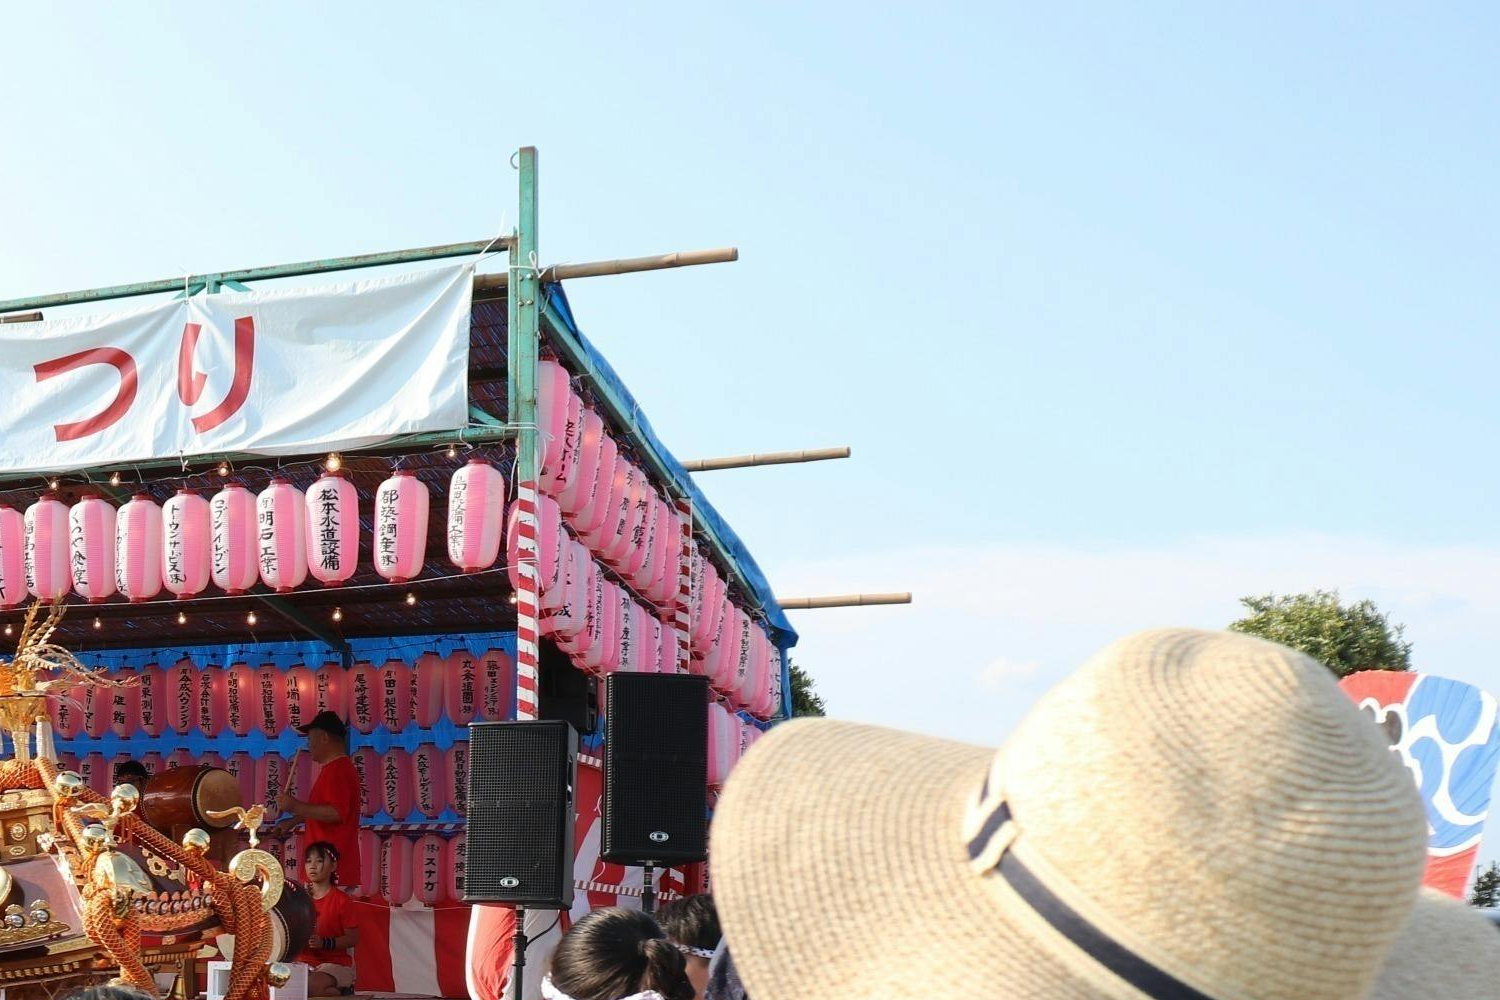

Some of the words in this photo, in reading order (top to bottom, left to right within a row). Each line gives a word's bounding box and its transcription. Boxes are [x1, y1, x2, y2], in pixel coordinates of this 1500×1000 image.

[319, 488, 340, 571] 松本水道設備
